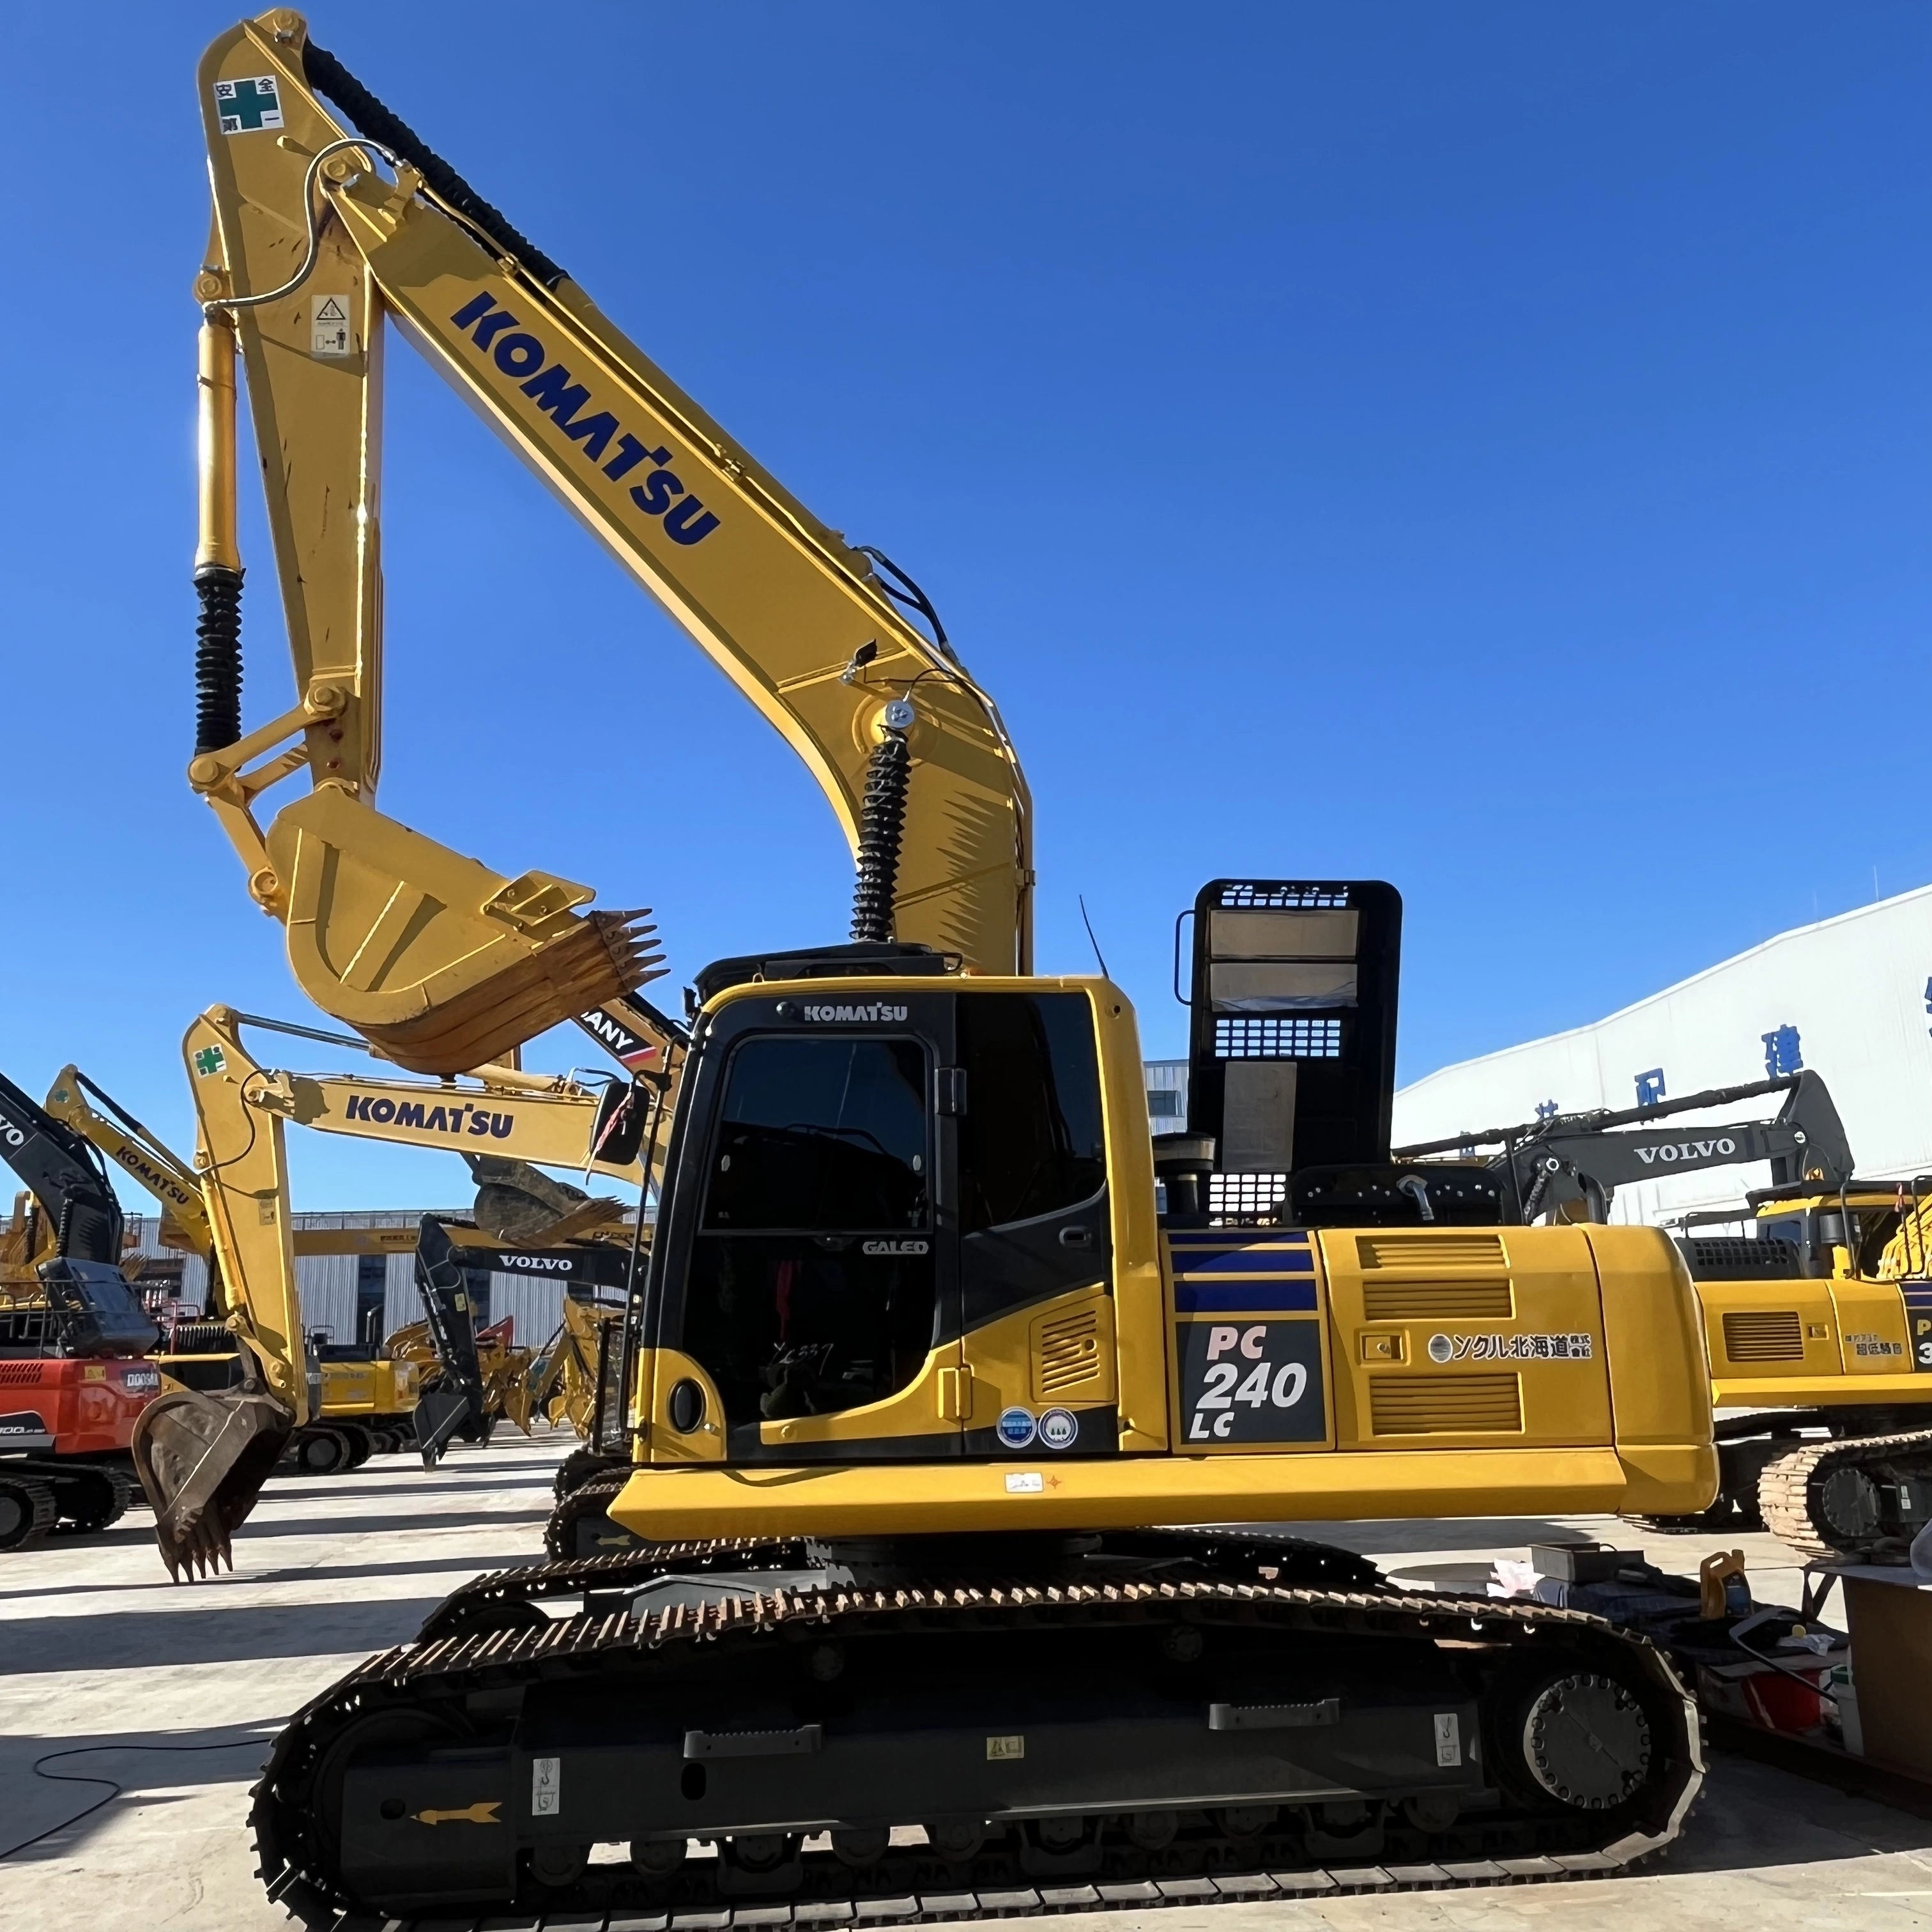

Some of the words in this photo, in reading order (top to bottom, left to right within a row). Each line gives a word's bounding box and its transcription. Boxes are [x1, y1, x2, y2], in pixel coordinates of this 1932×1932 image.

[450, 291, 721, 546] KOMATSU
[804, 1002, 908, 1022] KOMATSU
[580, 1011, 634, 1050] ANY
[346, 1095, 514, 1139] KOMATSU
[1633, 1138, 1736, 1164] VOLVO
[116, 1146, 189, 1204] KOMATSU
[499, 1254, 572, 1271] VOLVO
[862, 1241, 929, 1255] GALEO
[1206, 1326, 1267, 1360] PC
[1195, 1362, 1308, 1409] 240
[1188, 1411, 1235, 1439] LC
